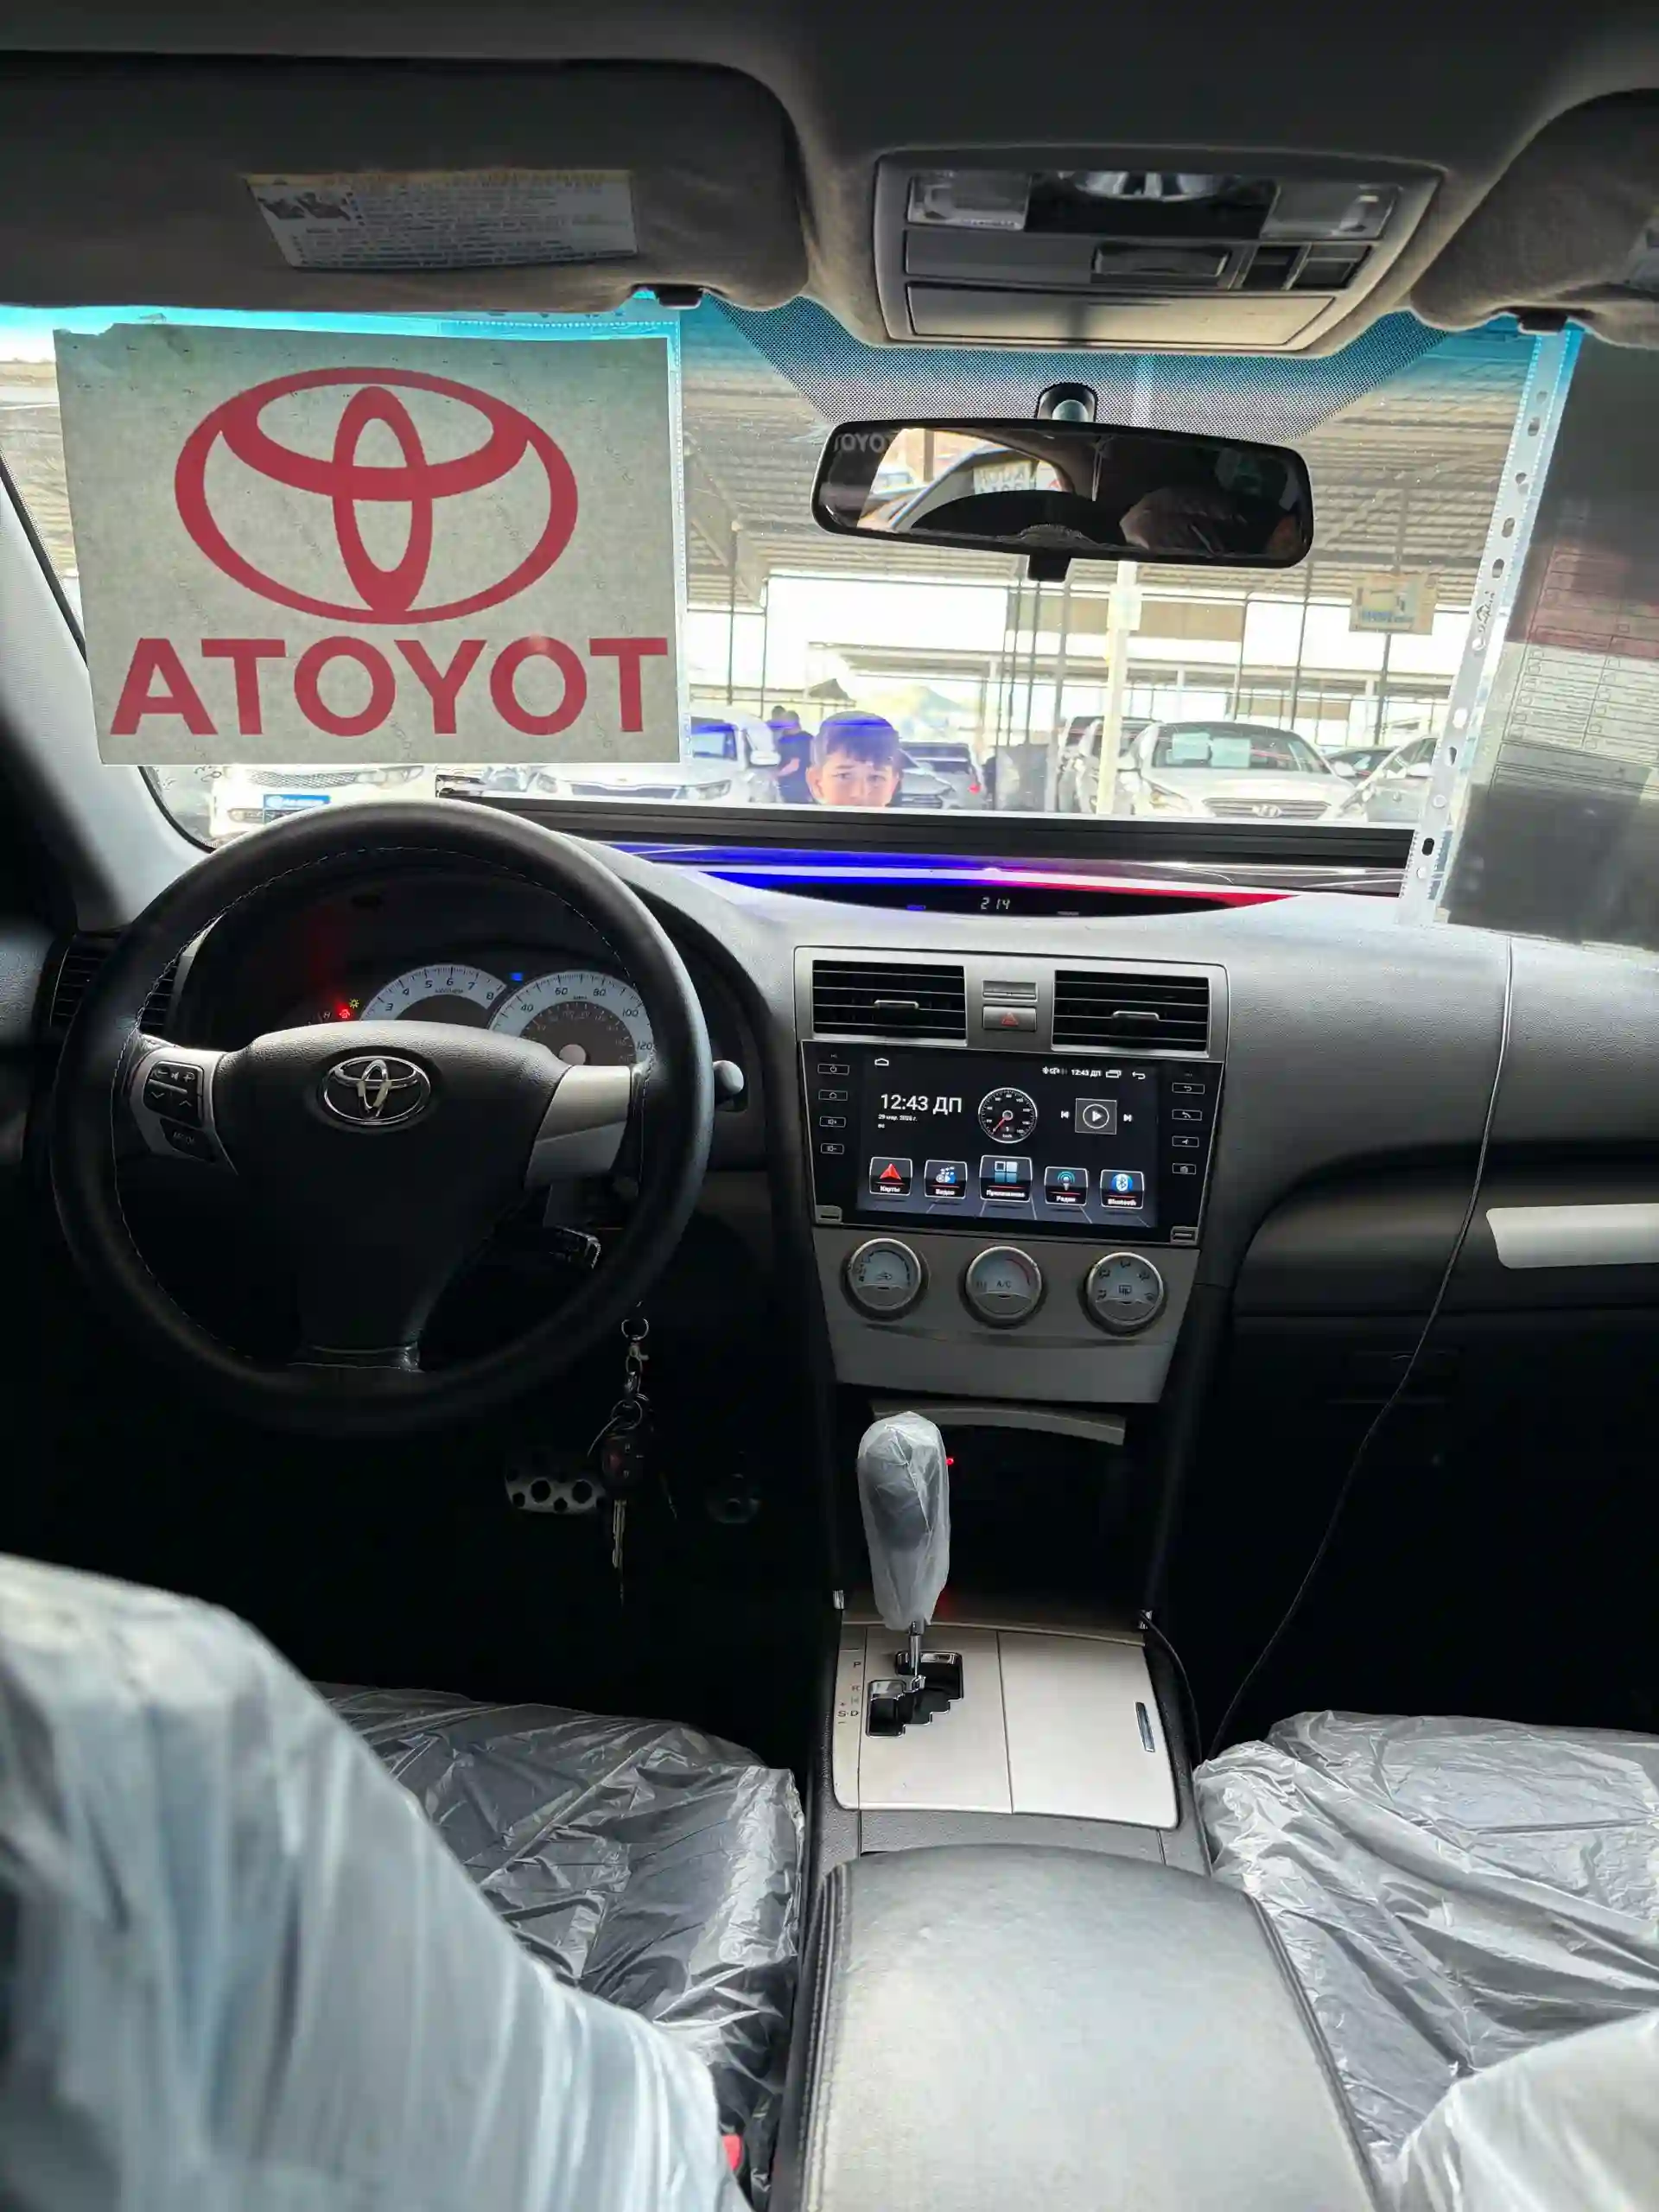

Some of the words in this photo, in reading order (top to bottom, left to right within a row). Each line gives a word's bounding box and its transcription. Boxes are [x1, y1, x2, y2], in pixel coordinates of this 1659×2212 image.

[424, 980, 433, 988] 5
[467, 982, 476, 991] 7
[554, 987, 569, 995] 60
[593, 988, 607, 996] 80
[385, 1001, 394, 1011] 3
[520, 1003, 534, 1013] 40
[622, 1007, 639, 1018] 100
[637, 1039, 653, 1051] 120
[880, 1093, 929, 1111] 12:43
[933, 1096, 963, 1116] ДП
[996, 1280, 1012, 1288] A/C
